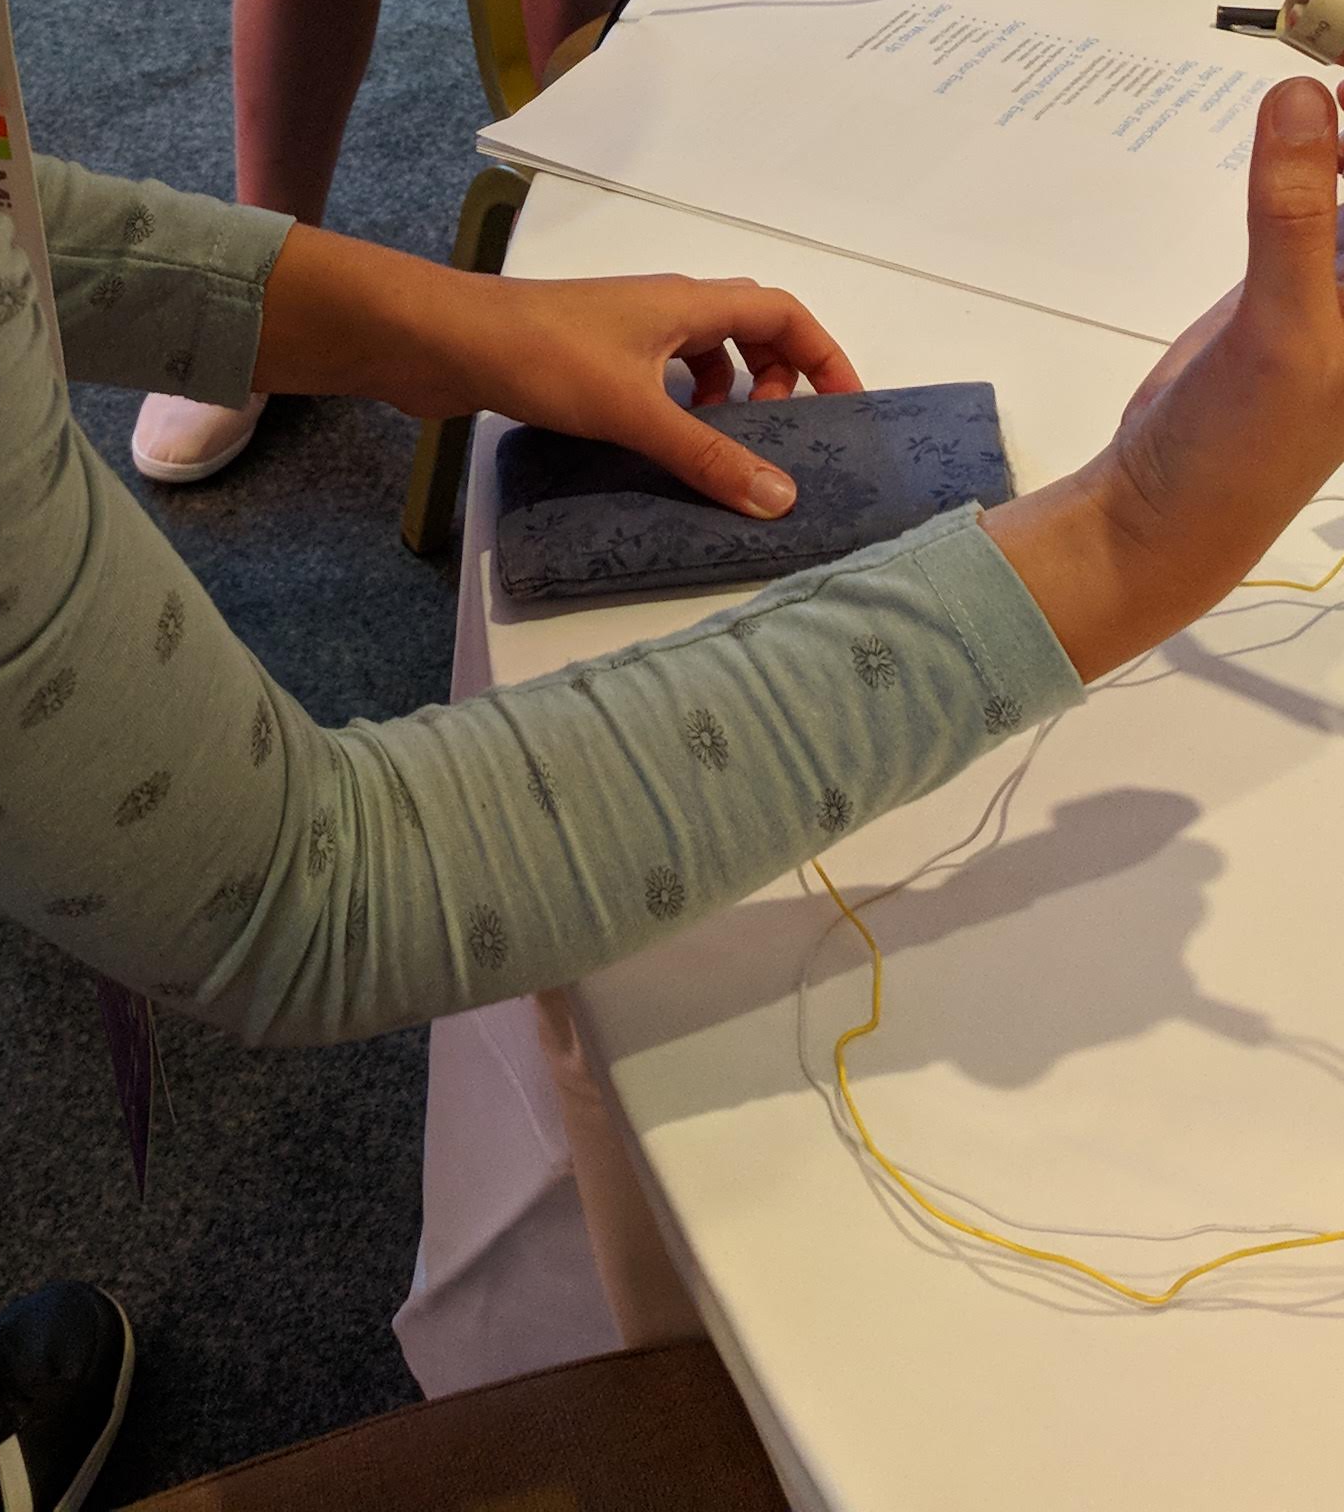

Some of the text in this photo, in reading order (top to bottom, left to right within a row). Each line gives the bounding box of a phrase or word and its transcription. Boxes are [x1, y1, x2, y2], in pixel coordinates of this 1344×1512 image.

[896, 24, 928, 43] Wrap
[931, 73, 965, 95] Event
[991, 104, 1026, 127] Event
[1108, 115, 1142, 136] Event
